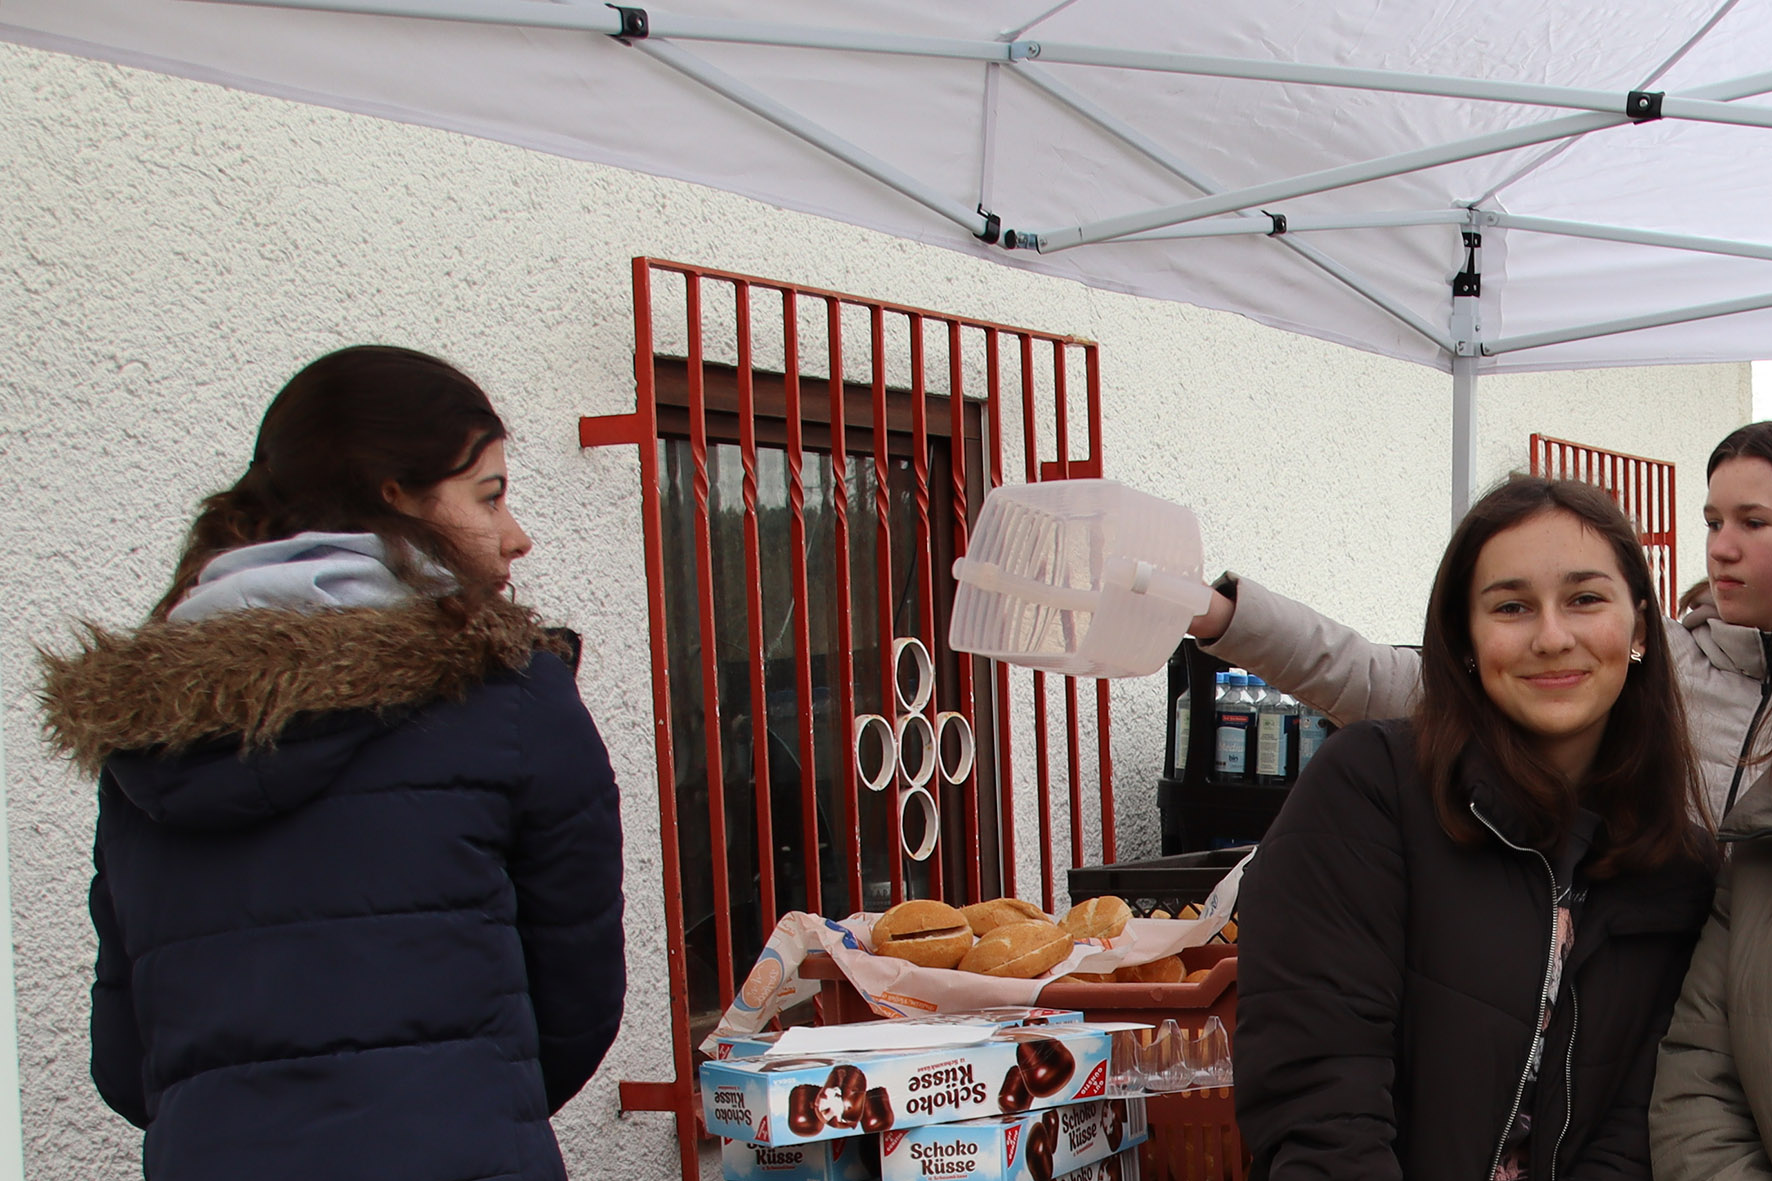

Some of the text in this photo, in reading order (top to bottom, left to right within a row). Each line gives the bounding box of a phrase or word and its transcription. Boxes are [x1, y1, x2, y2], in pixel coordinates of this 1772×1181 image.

[908, 1063, 974, 1092] Küsse
[714, 1091, 745, 1109] Küsse
[906, 1082, 987, 1115] Schoko
[715, 1107, 752, 1127] Schoko
[1062, 1102, 1097, 1134] Schoko
[1068, 1123, 1097, 1151] Küsse
[755, 1149, 803, 1166] Küsse
[910, 1139, 978, 1160] Schoko
[920, 1159, 976, 1176] Küsse
